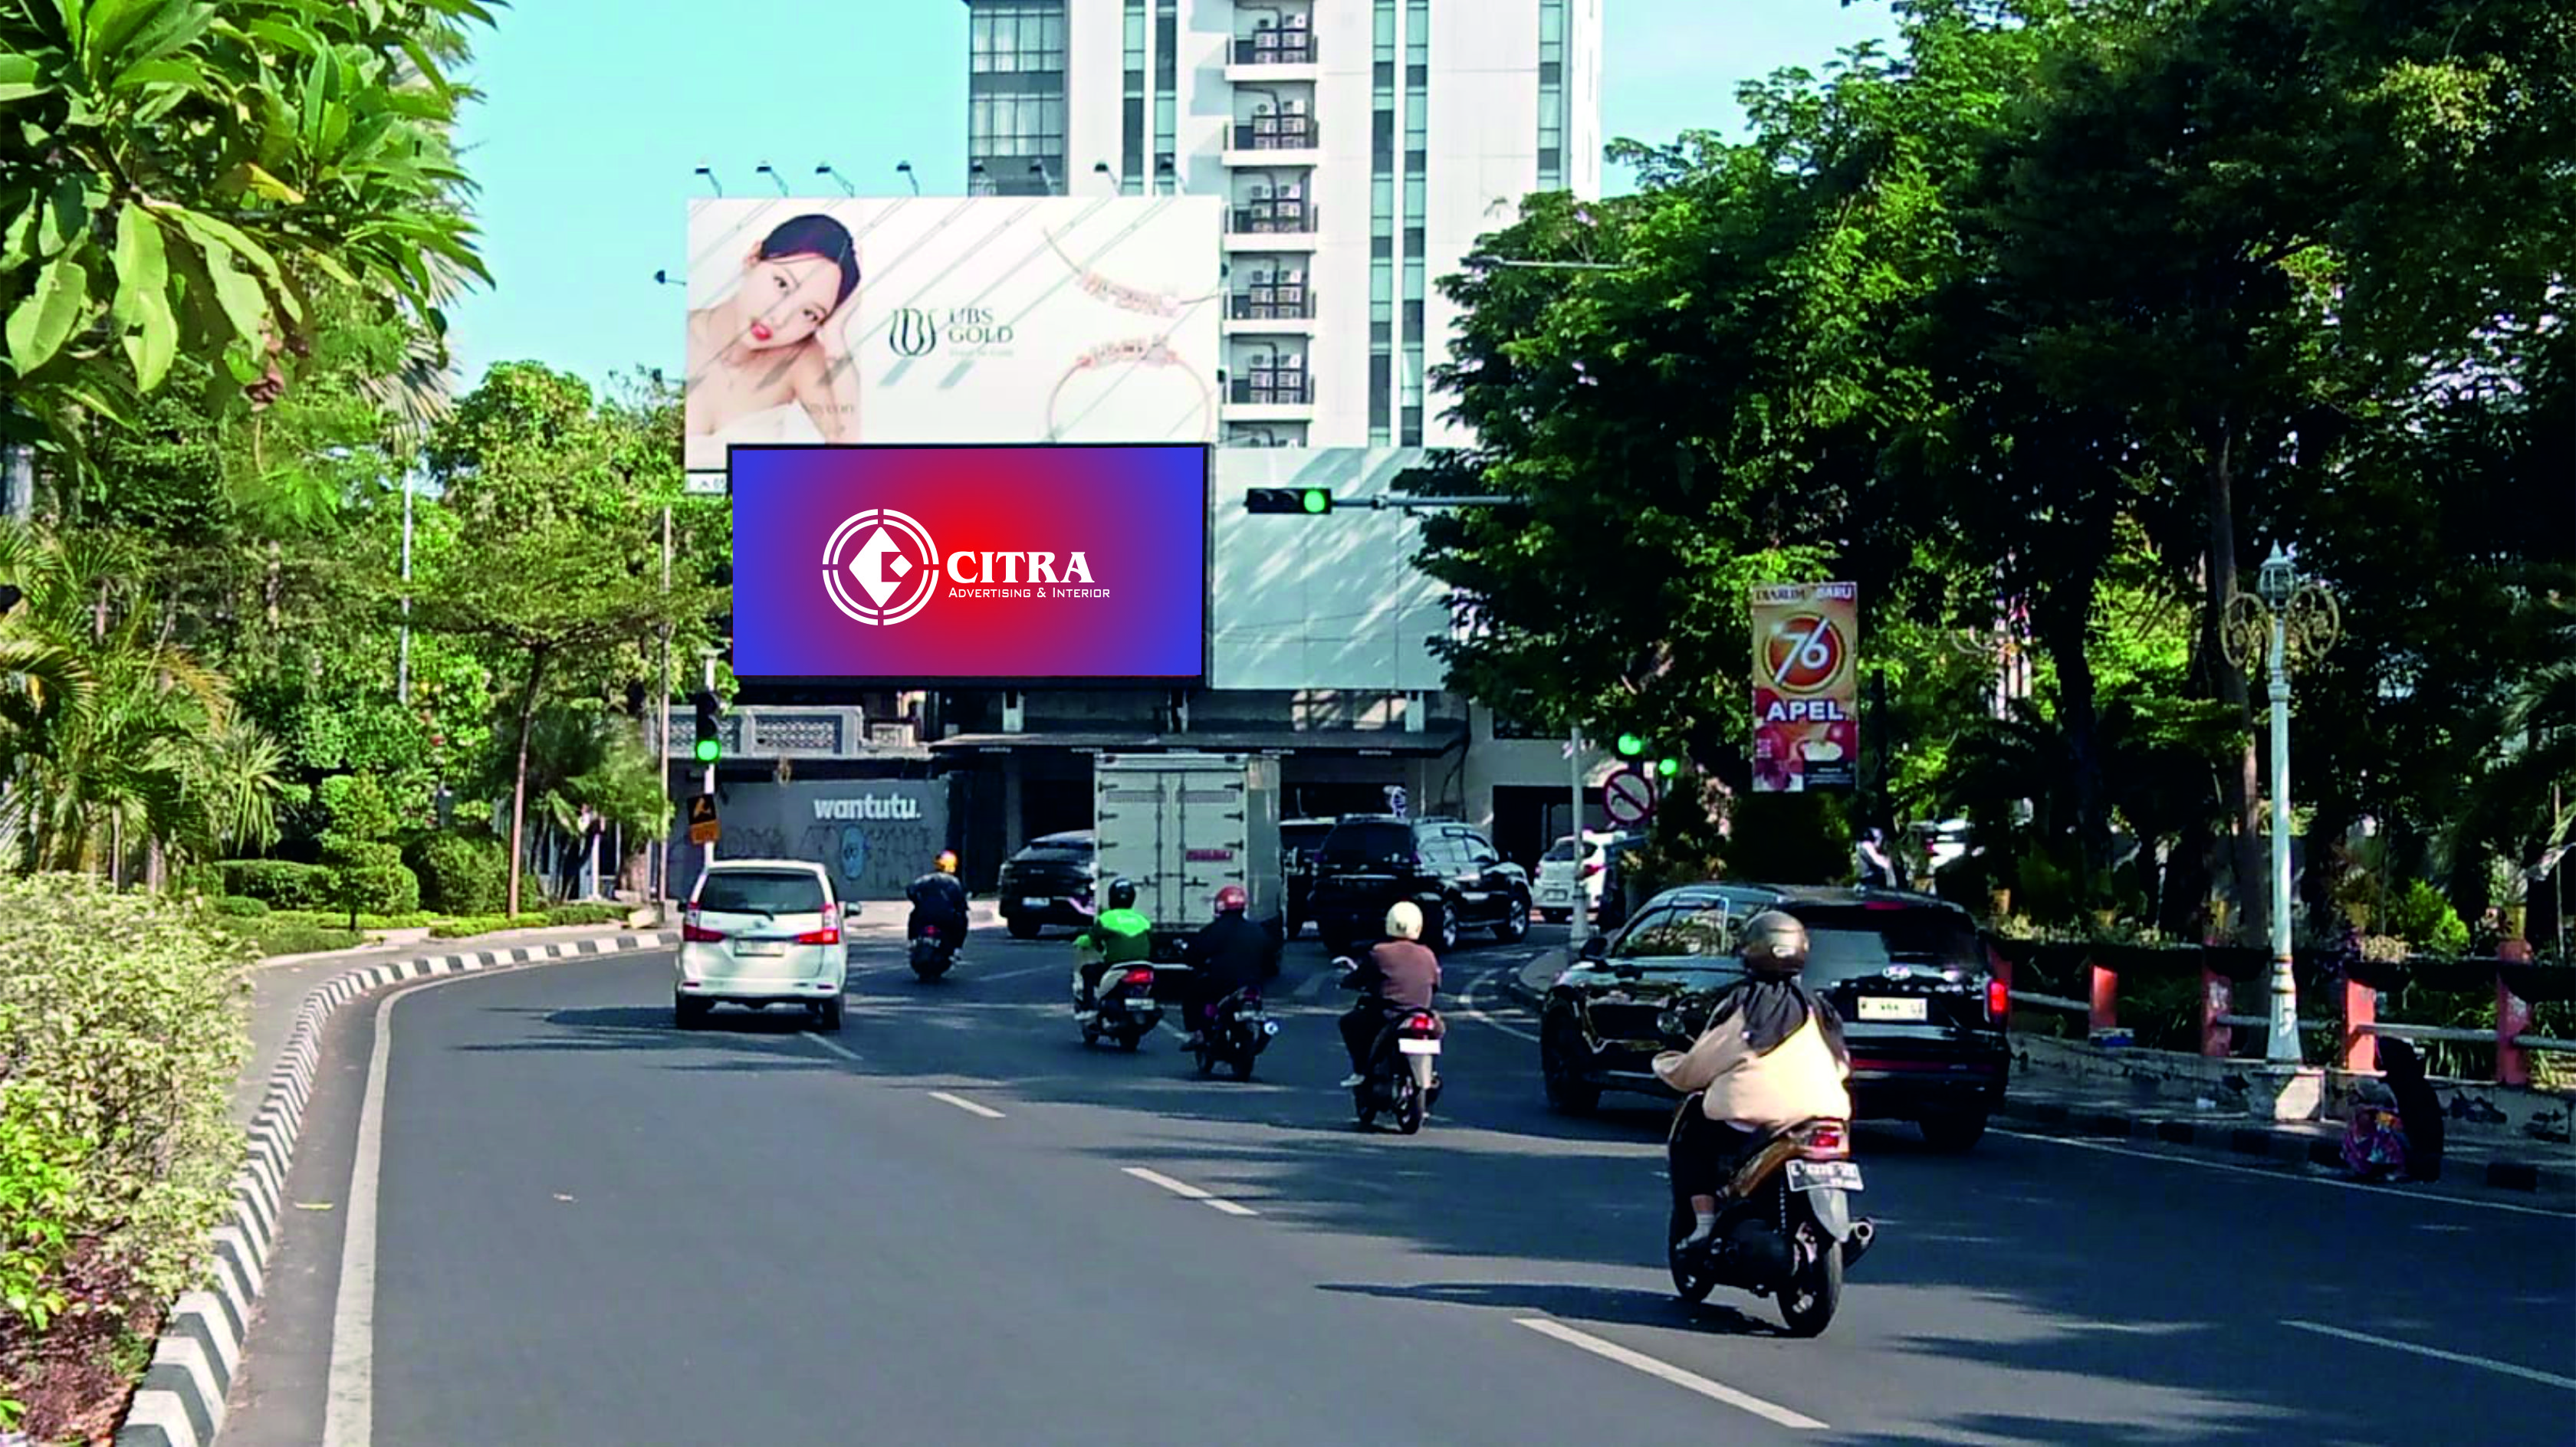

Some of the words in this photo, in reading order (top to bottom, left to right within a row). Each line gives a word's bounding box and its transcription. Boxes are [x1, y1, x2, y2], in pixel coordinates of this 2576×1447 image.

[949, 308, 994, 325] UBS
[948, 326, 1014, 343] GOLD
[947, 551, 1095, 583] CITRA
[1037, 587, 1046, 598] &
[1771, 617, 1830, 687] 76
[1766, 701, 1844, 721] APEL
